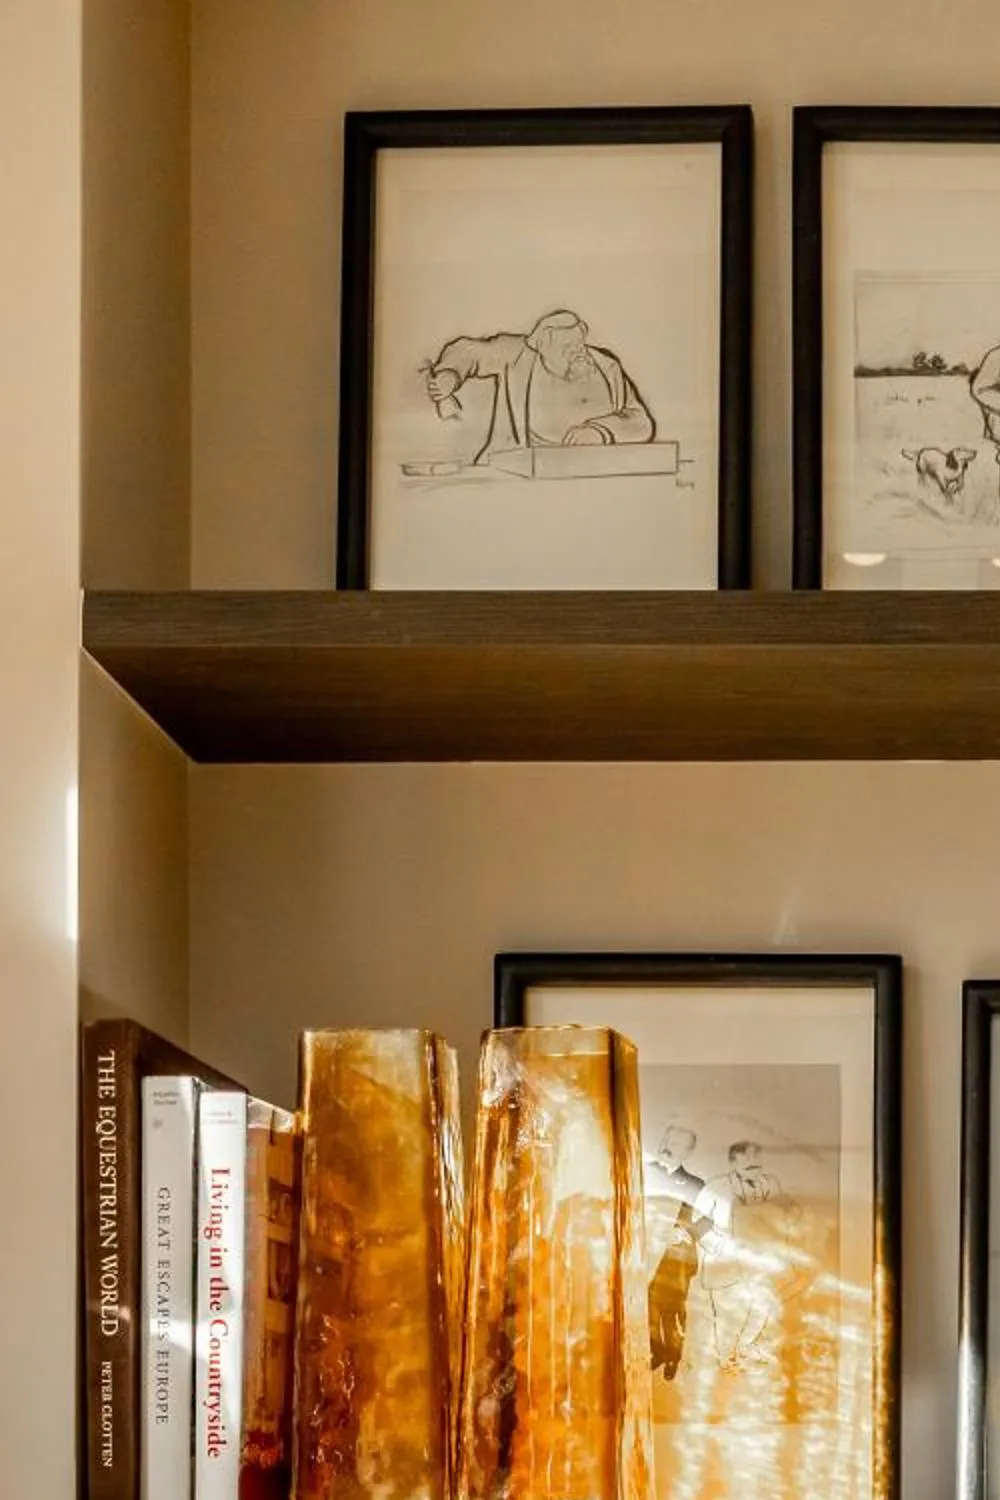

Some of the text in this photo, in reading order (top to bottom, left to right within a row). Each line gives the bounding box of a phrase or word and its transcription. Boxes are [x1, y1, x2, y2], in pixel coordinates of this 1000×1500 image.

[96, 1050, 120, 1336] THE EQUESTRIAN WORLD
[155, 1187, 172, 1425] GREAT ESCAPES EUROPE
[203, 1168, 230, 1459] Living in the Countryside
[101, 1361, 113, 1467] PETER CLOTTEN
